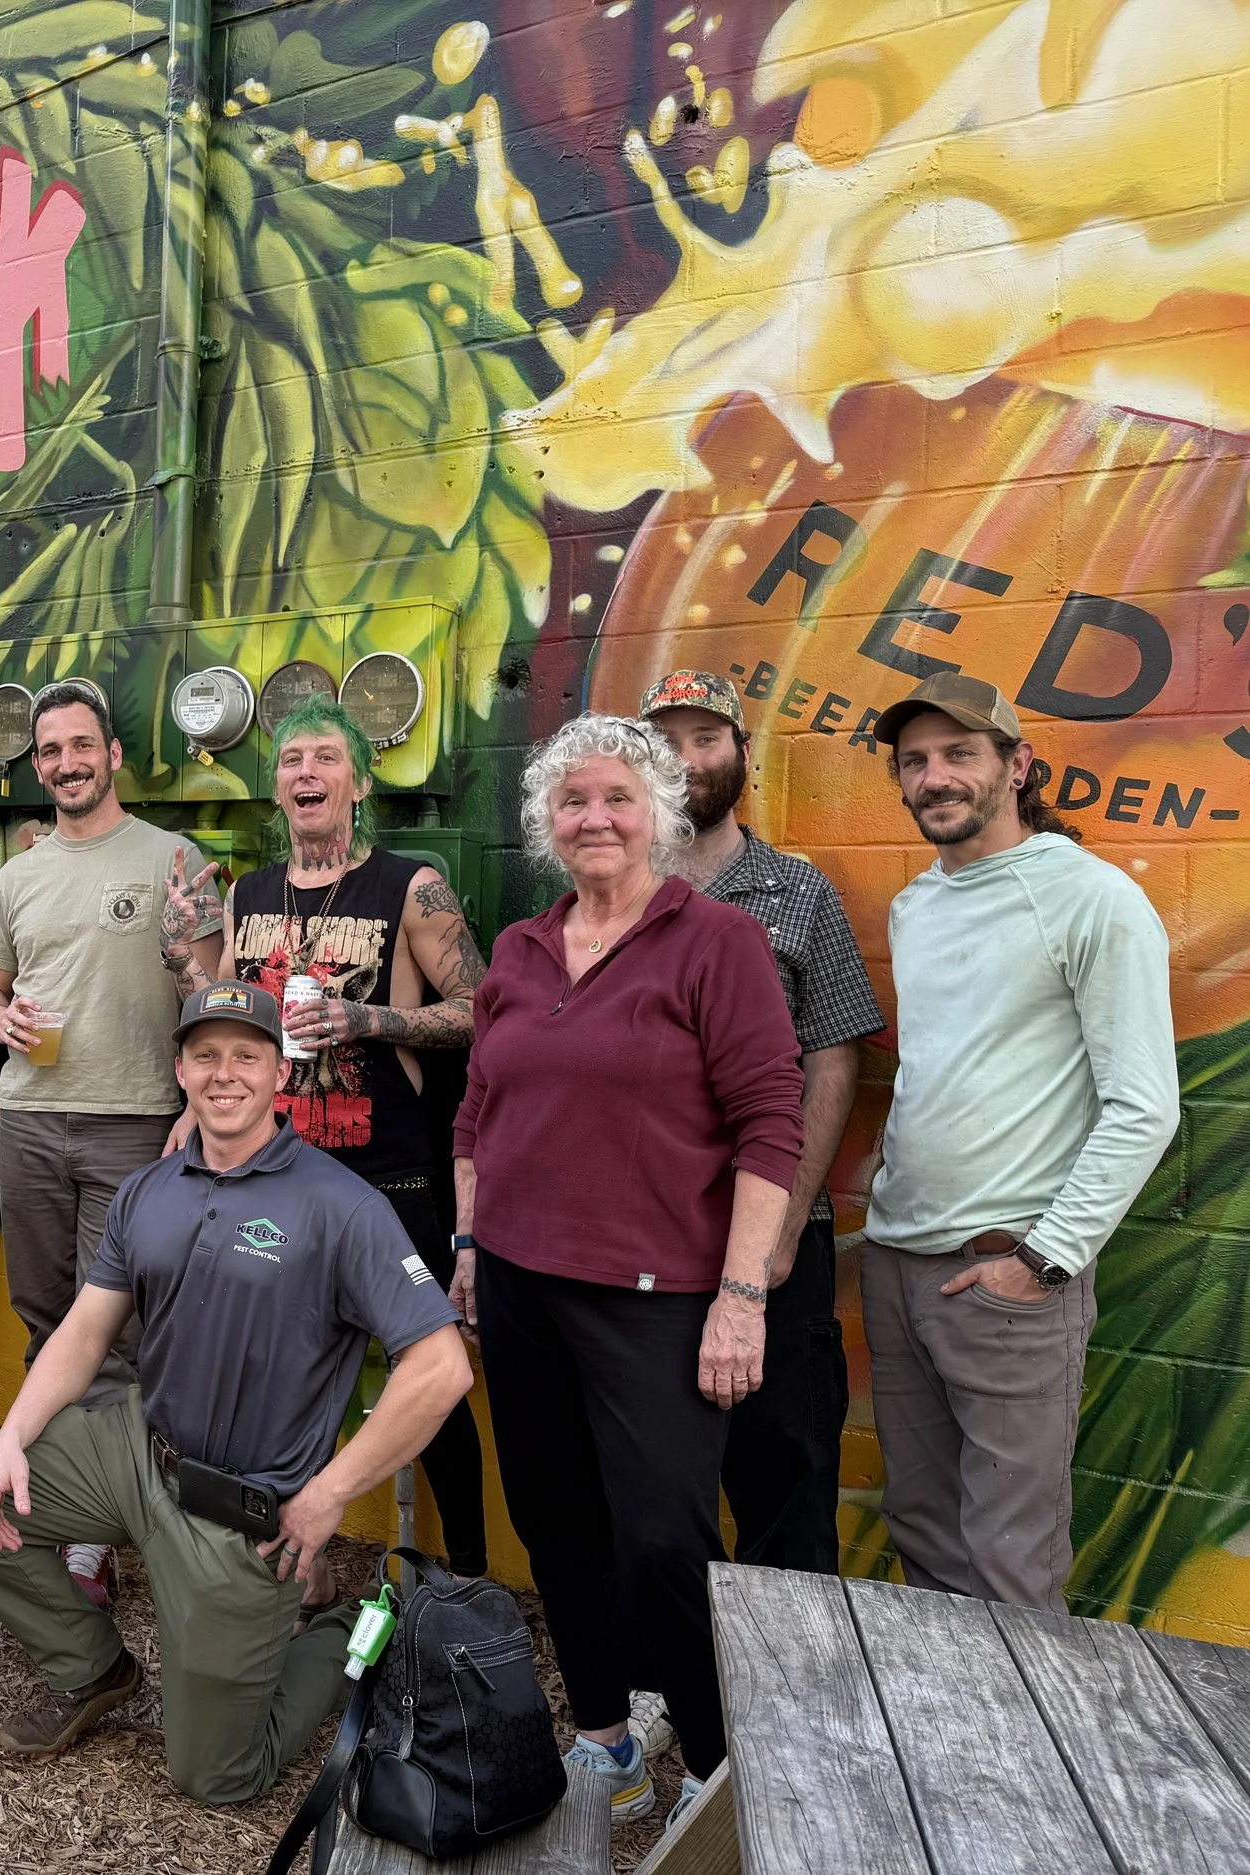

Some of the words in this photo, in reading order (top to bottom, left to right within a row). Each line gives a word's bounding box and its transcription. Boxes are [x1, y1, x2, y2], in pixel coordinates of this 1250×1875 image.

[747, 499, 1250, 762] RED'
[236, 1224, 289, 1245] KELLCO
[233, 1244, 249, 1253] PEST
[249, 1248, 281, 1263] CONTROL
[362, 1613, 377, 1639] clover
